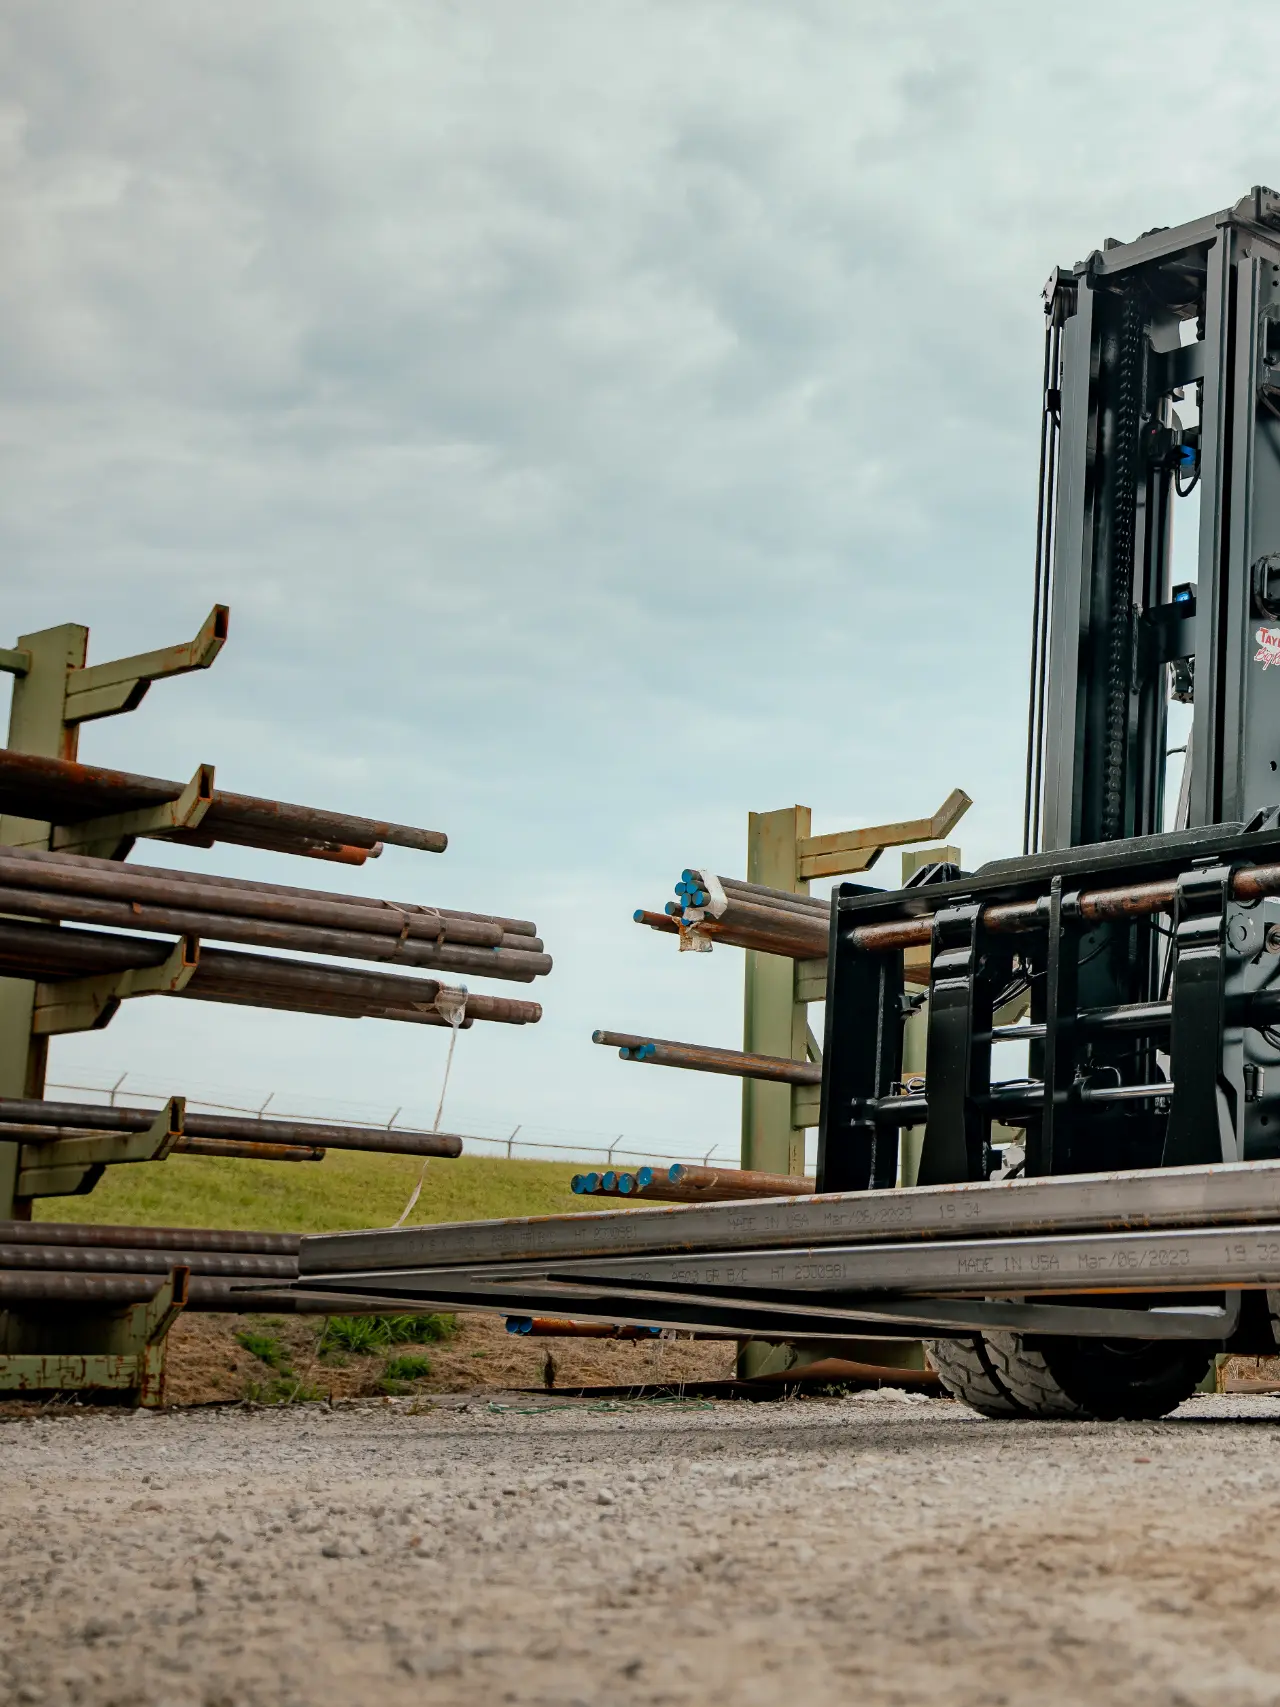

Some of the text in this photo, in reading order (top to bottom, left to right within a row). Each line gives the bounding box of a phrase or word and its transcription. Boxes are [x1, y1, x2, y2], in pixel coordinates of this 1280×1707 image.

[1255, 647, 1273, 670] Big
[957, 1255, 995, 1274] MADE
[1004, 1257, 1022, 1272] IN
[1031, 1254, 1060, 1271] USA
